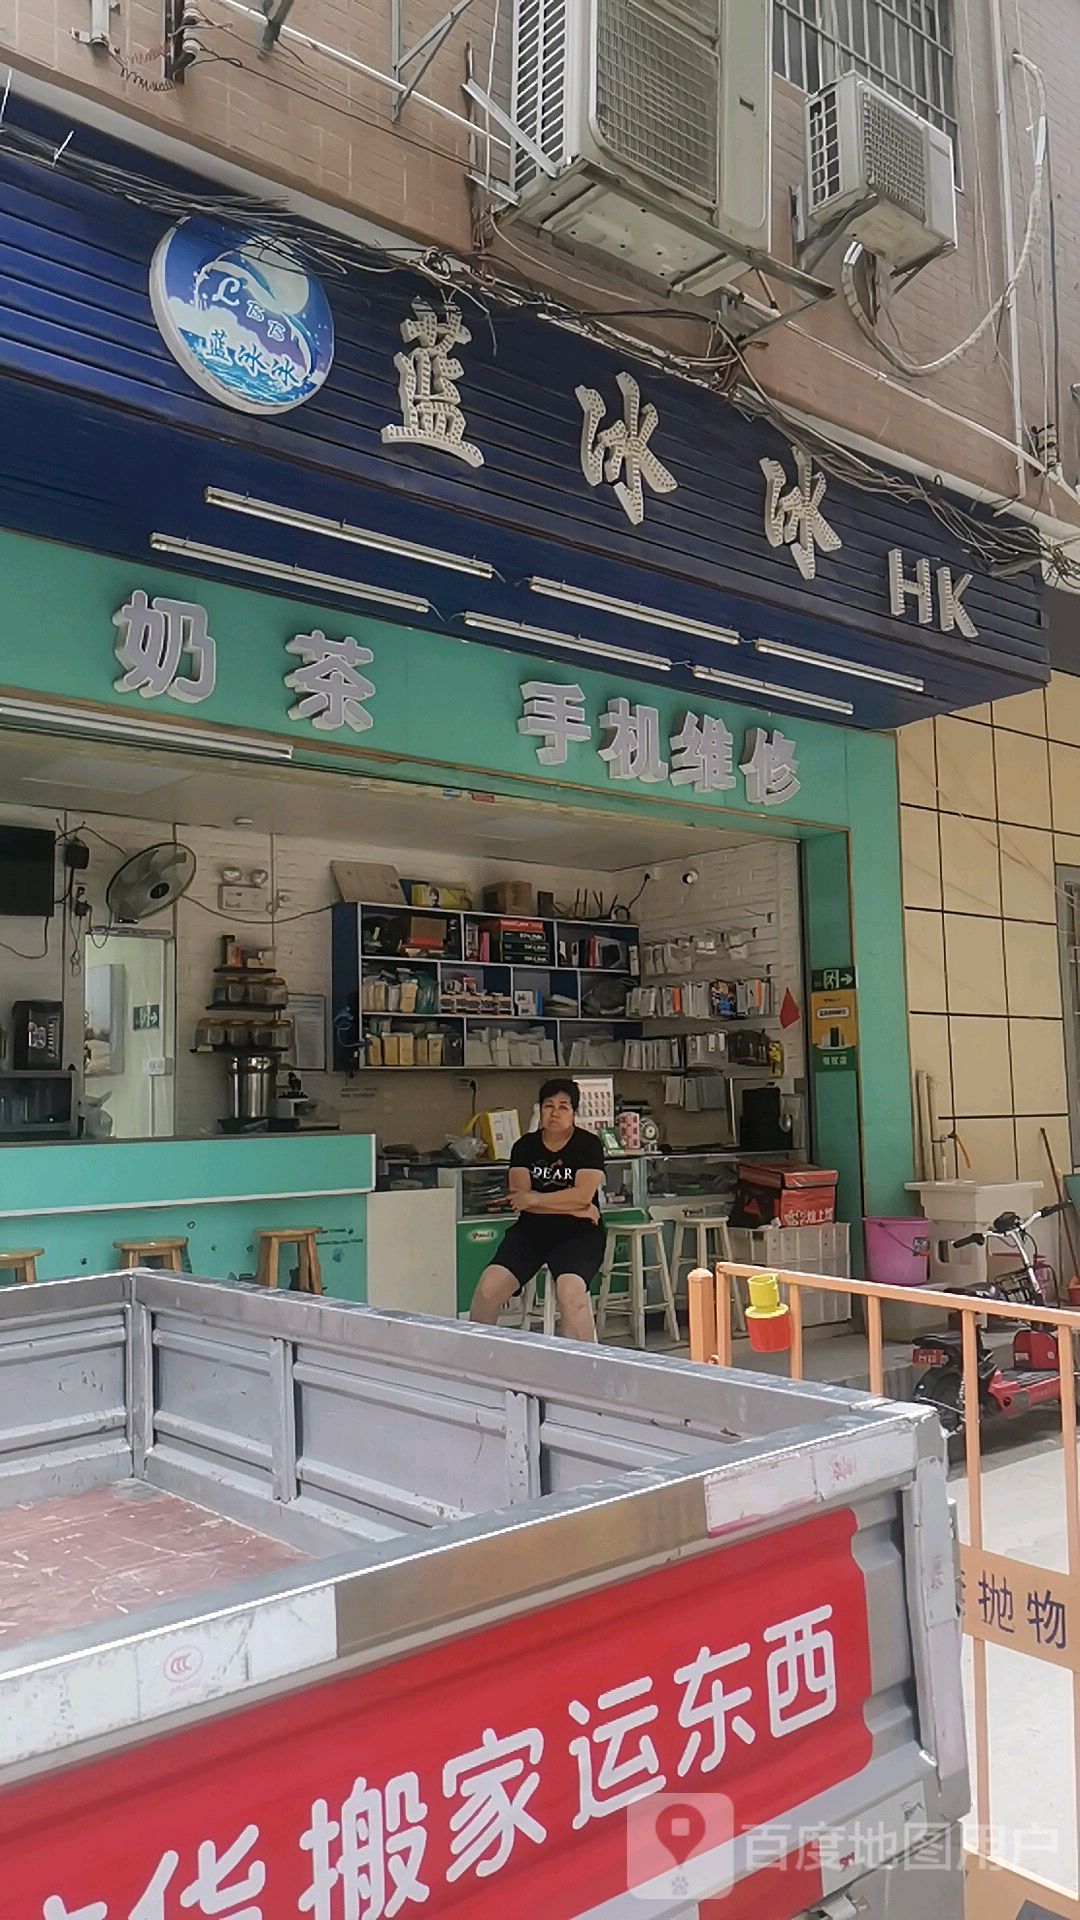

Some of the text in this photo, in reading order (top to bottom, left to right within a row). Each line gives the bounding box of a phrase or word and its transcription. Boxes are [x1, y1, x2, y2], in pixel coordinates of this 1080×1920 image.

[888, 548, 979, 638] HK
[112, 590, 802, 806] 奶茶 手机维修
[531, 1166, 573, 1180] DEAR
[959, 1568, 1068, 1649] 抛物
